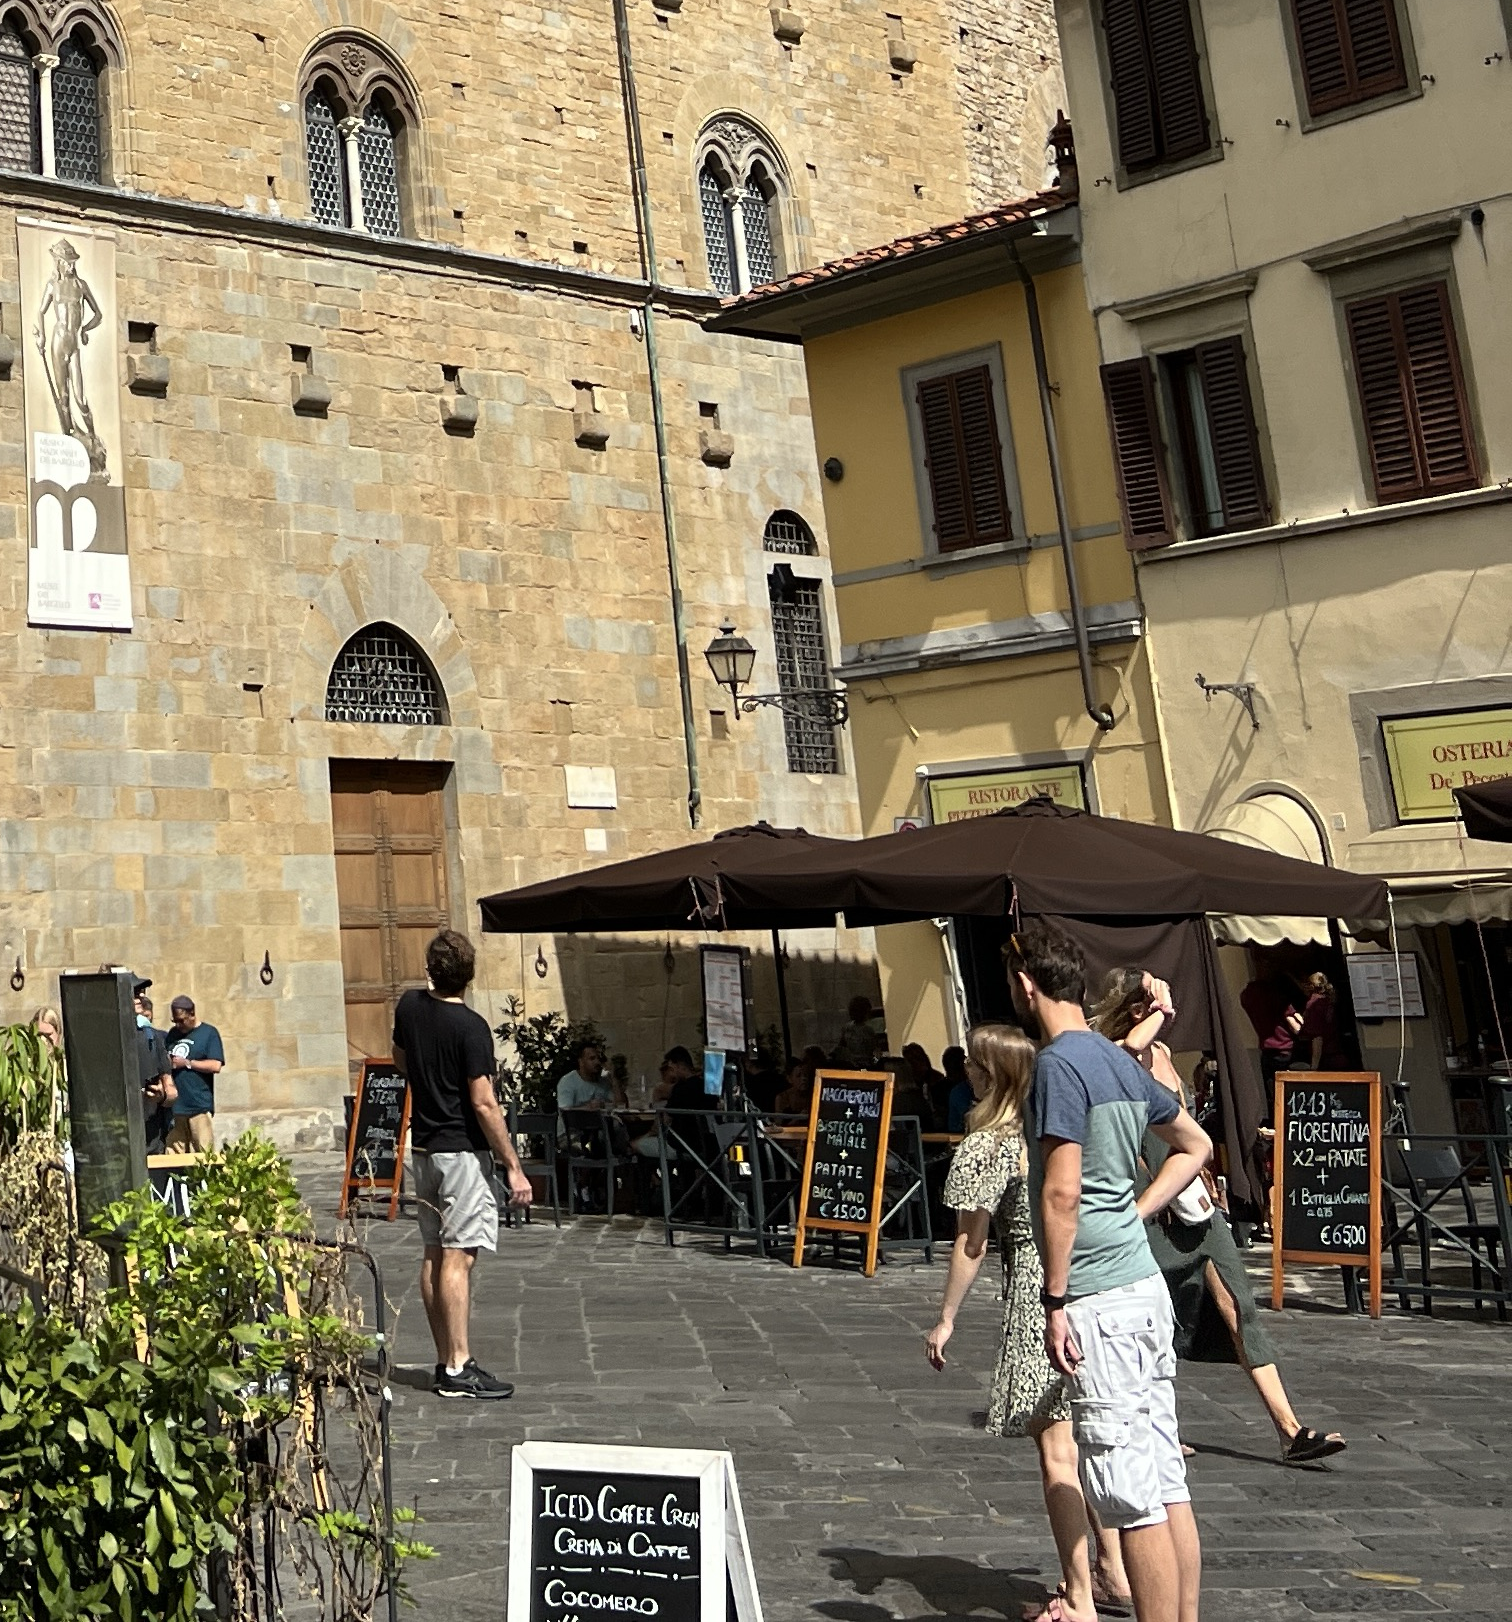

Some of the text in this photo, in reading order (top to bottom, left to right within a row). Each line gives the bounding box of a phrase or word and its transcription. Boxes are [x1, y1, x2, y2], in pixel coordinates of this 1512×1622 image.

[968, 782, 1063, 805] RISTORANTE
[1288, 1119, 1370, 1143] FIORENTINA
[815, 1161, 863, 1179] PATATE
[1328, 1148, 1368, 1168] PATATE
[539, 1485, 594, 1522] ICED
[554, 1527, 605, 1556] CREMA
[544, 1579, 659, 1615] COCOMERO
